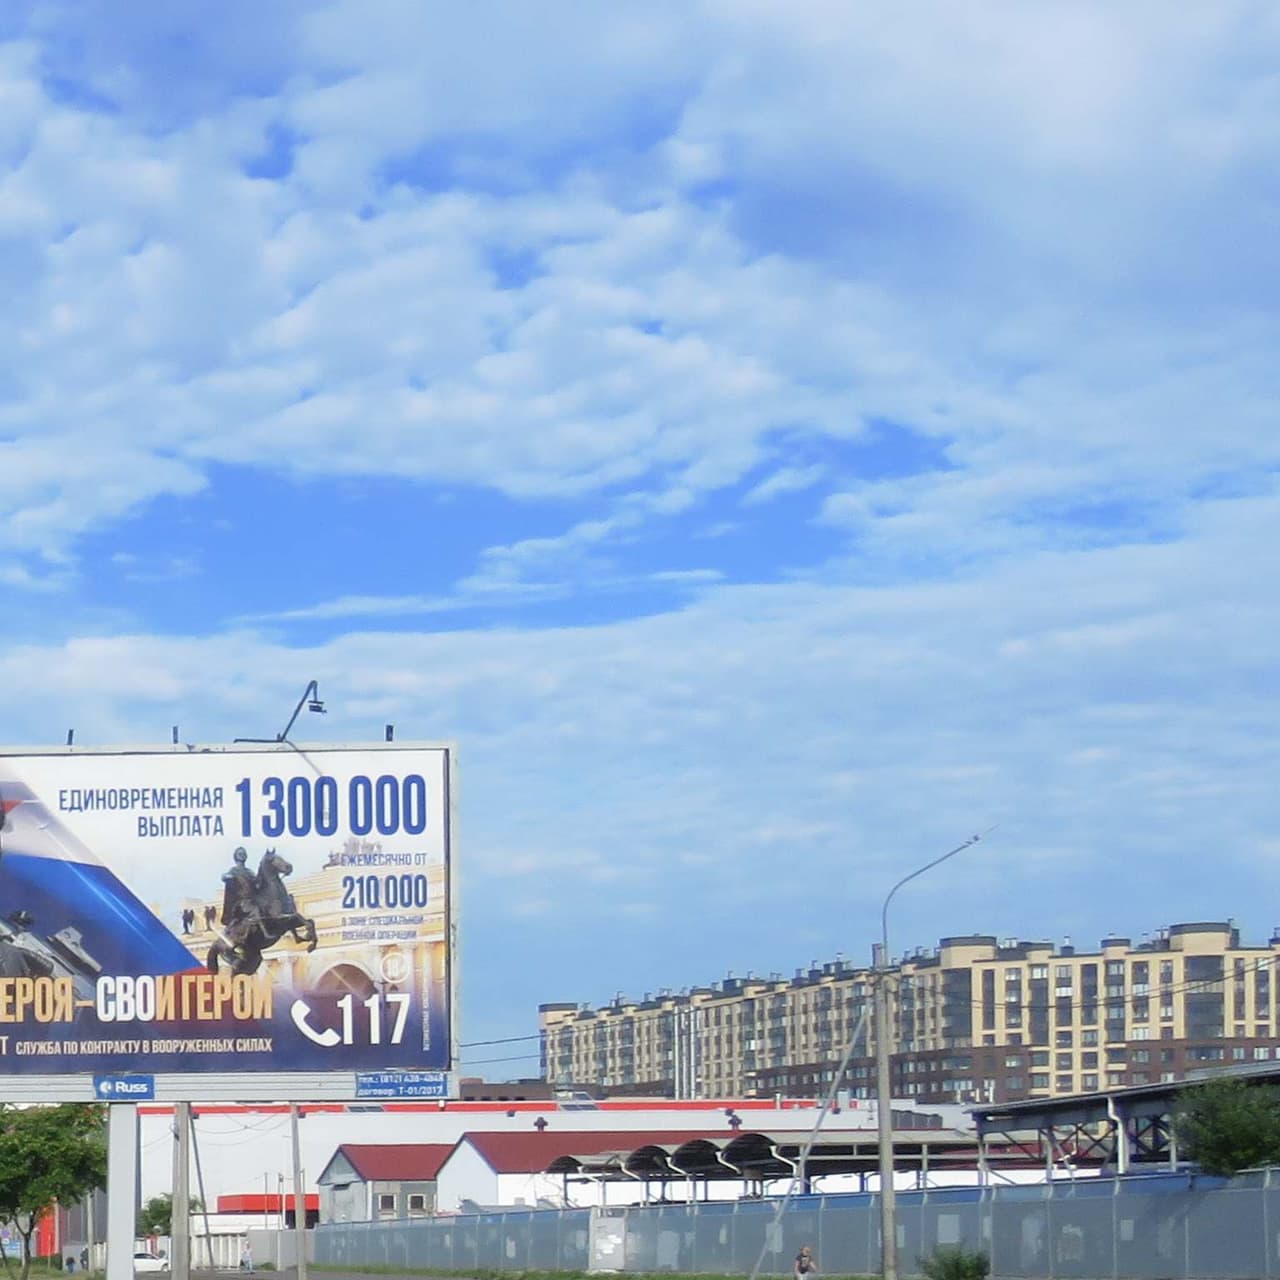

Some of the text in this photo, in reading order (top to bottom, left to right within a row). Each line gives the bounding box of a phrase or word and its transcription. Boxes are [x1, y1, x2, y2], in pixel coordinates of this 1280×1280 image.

[59, 787, 224, 812] ЕДИНОВРЕМЕННАЯ
[235, 774, 426, 837] 1 300 000
[138, 815, 224, 837] ВЫПЛАТА
[415, 853, 427, 865] ОТ
[342, 874, 427, 909] 210 000
[96, 975, 175, 1022] СВОИ
[182, 974, 272, 1021] ГЕРОИ
[337, 993, 410, 1044] 117
[16, 1038, 273, 1055] СЛУЖБА ПО КОНТРАКТУ В ВООРУЖЕННЫХ СИЛАХ
[115, 1081, 148, 1093] Russ
